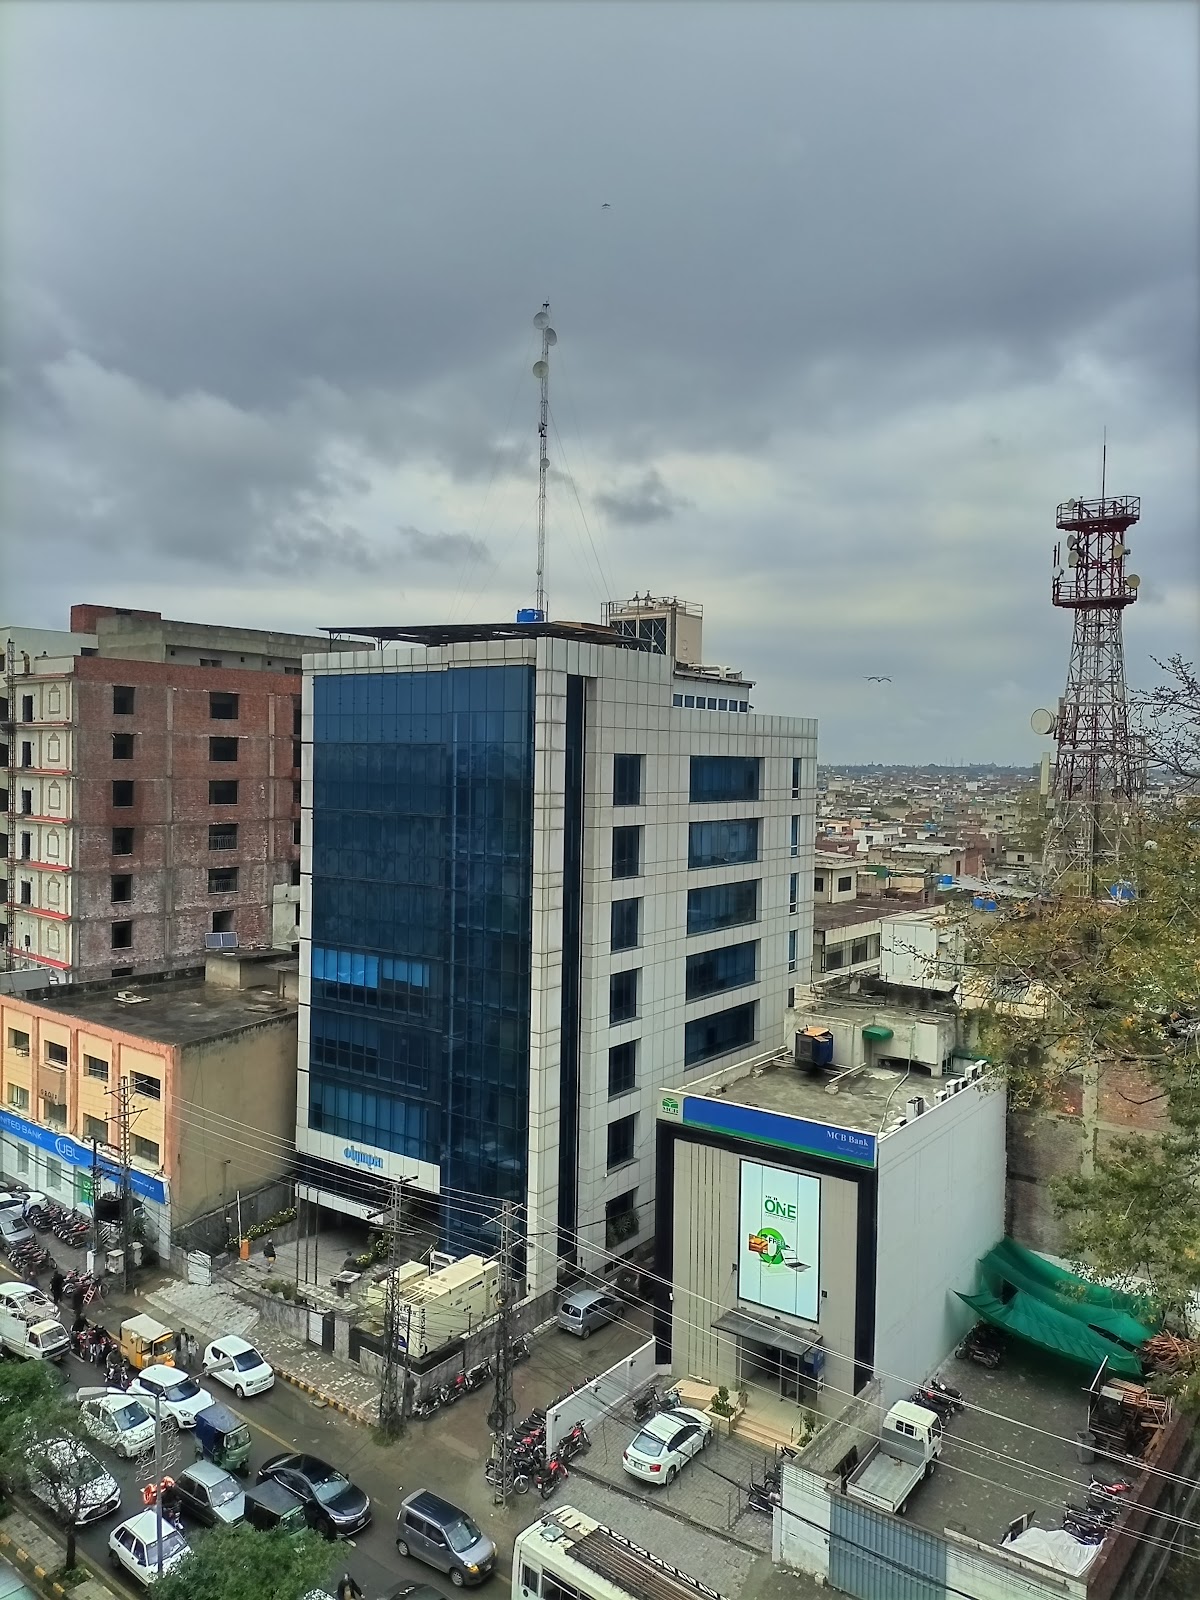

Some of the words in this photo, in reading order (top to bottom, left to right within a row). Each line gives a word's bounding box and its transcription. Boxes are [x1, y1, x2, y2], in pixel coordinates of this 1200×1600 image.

[21, 1125, 42, 1140] BANK
[826, 1130, 847, 1142] MCB
[848, 1135, 869, 1147] Bank
[58, 1140, 80, 1161] UBL
[764, 1199, 797, 1219] ONE
